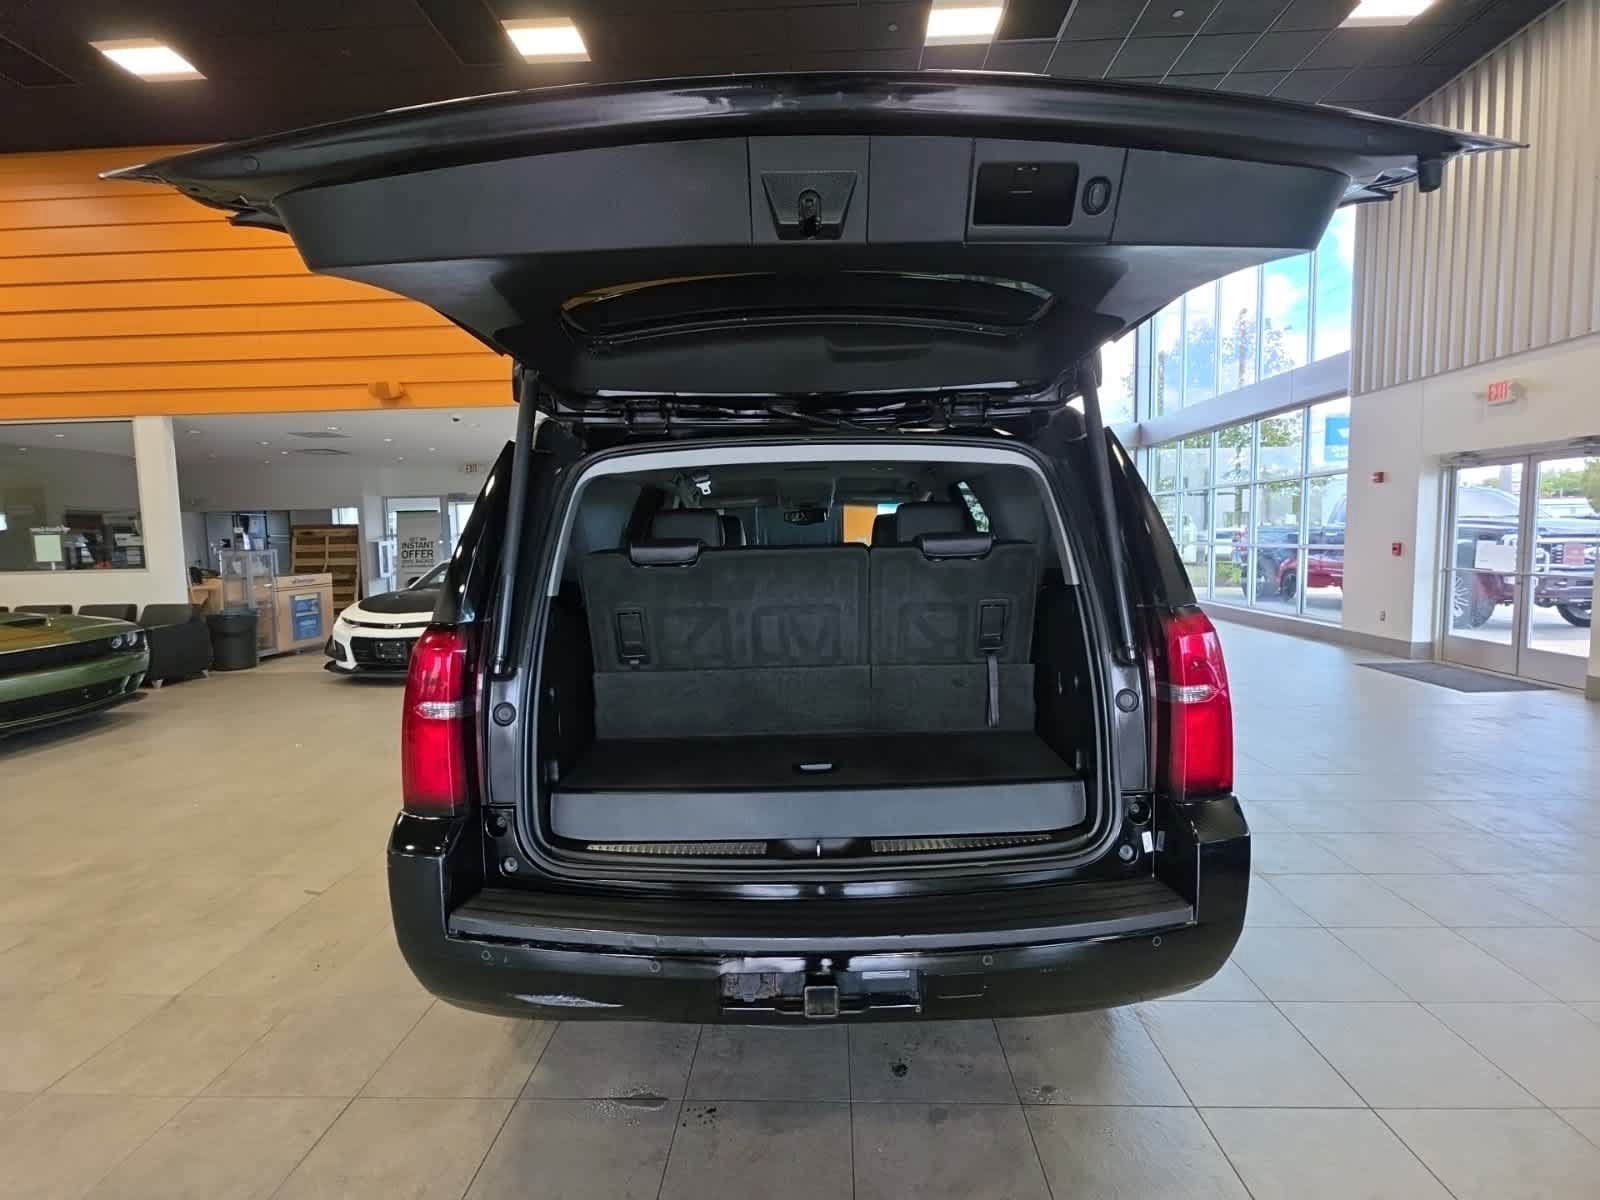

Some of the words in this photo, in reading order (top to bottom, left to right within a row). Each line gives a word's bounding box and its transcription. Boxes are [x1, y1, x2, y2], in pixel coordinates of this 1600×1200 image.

[1488, 382, 1508, 401] EXIT
[402, 541, 433, 549] INSTANT
[401, 549, 434, 559] OFFER
